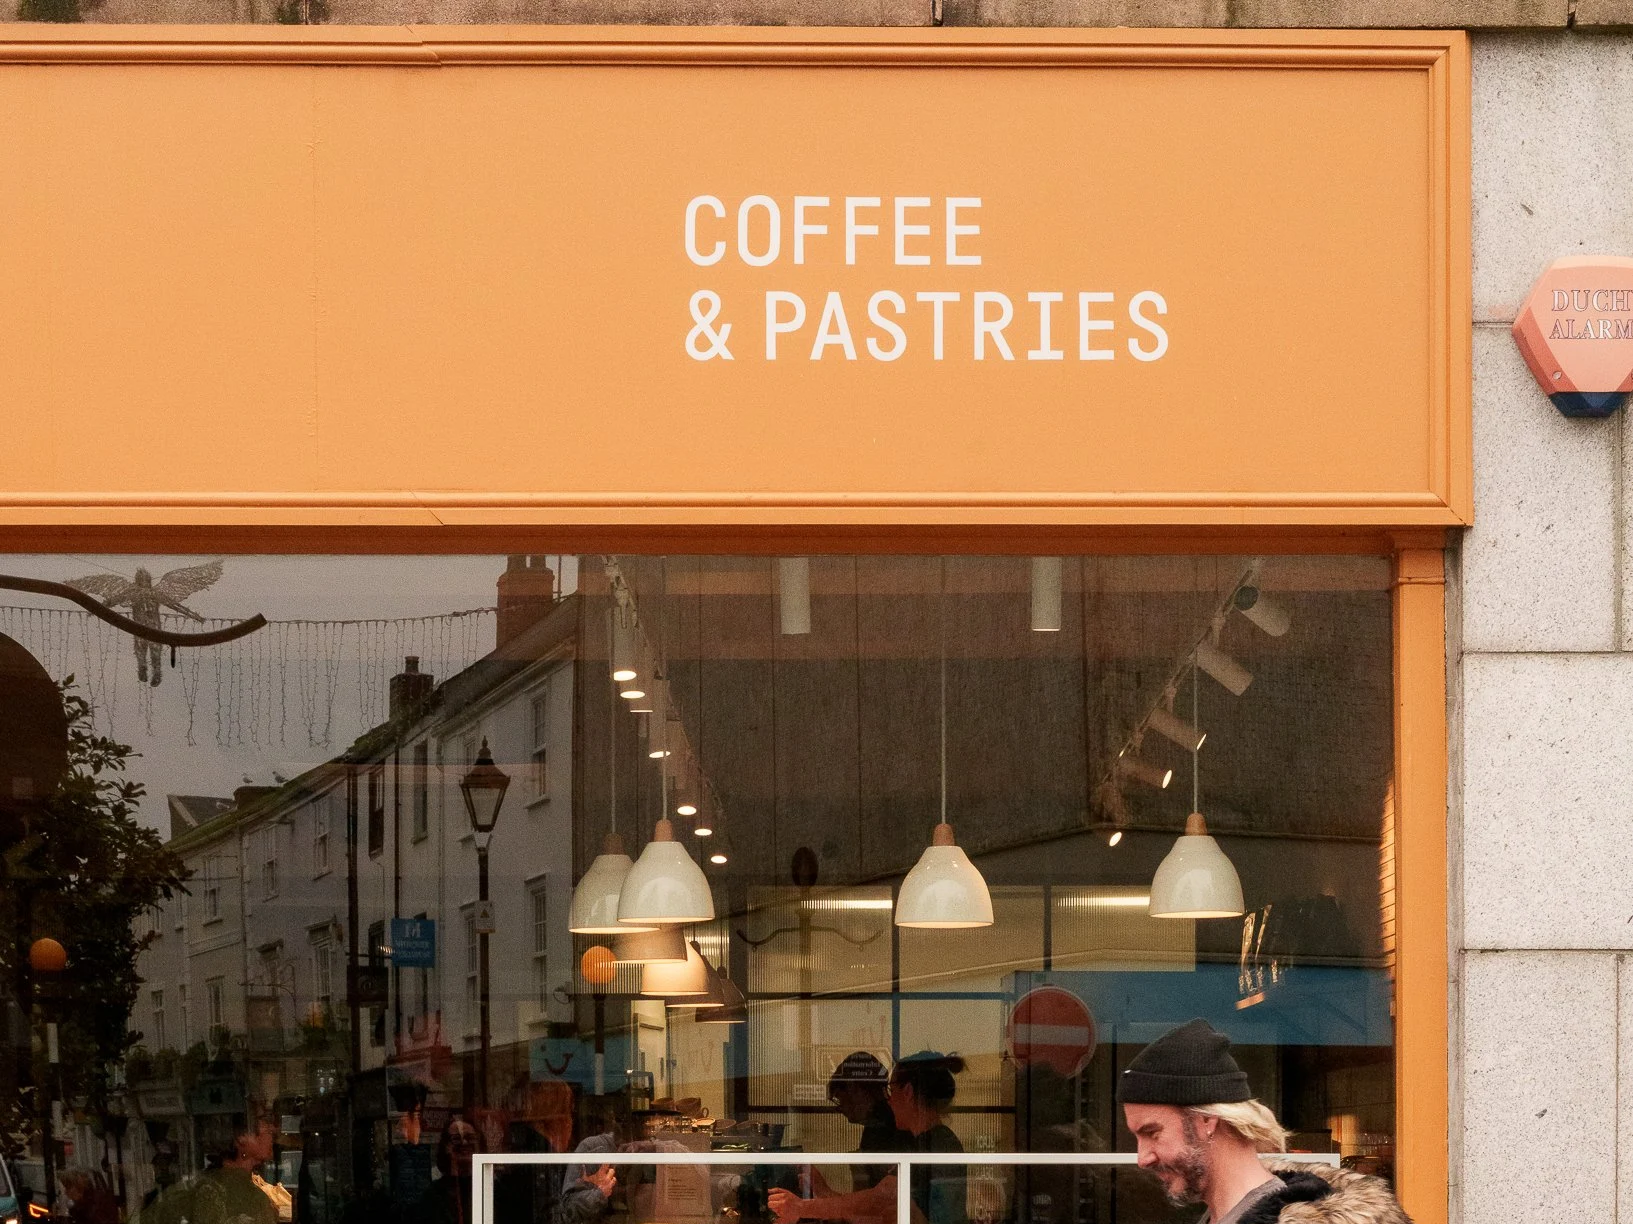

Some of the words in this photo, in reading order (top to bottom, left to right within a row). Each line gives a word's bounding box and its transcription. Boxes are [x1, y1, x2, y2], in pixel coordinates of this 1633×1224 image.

[684, 194, 983, 267] COFFEE
[684, 289, 736, 362] &
[765, 289, 1170, 362] PASTRIES
[1551, 289, 1633, 312] DUCH
